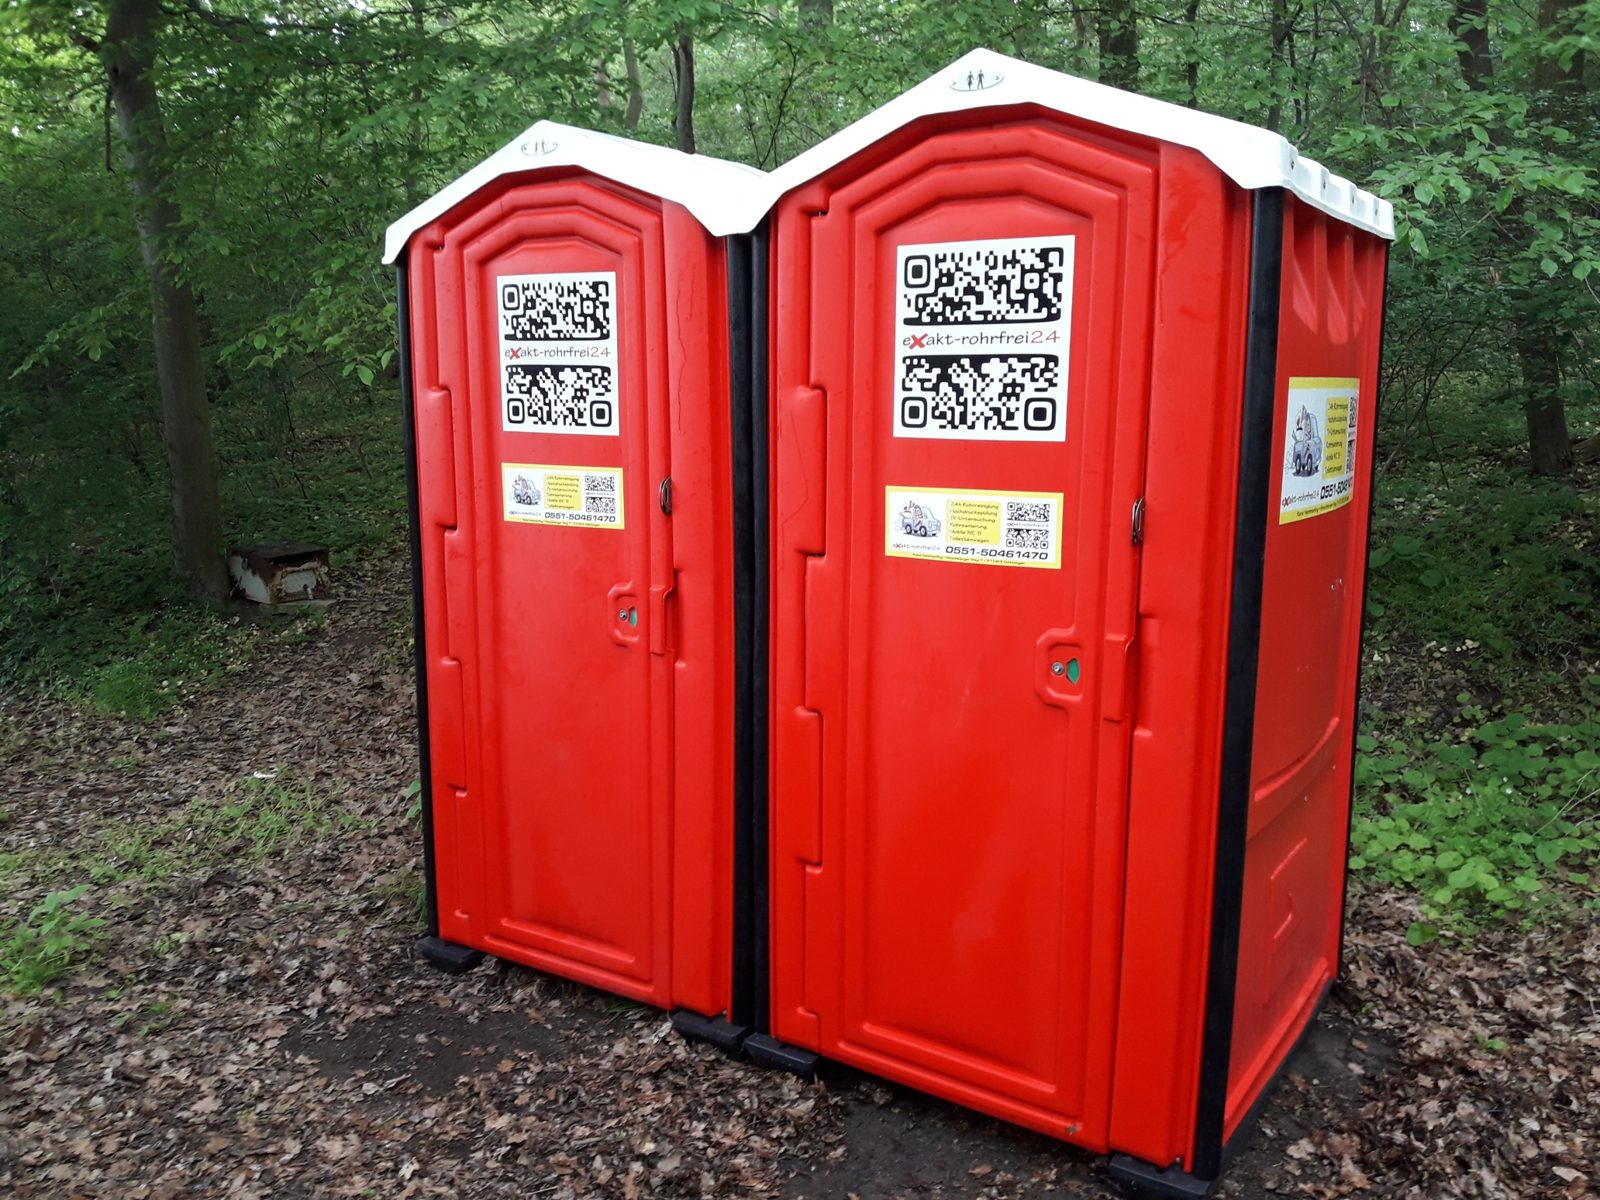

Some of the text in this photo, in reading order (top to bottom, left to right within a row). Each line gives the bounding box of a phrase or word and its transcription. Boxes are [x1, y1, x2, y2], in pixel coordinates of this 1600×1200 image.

[902, 330, 1061, 350] eXakt-rohrfrei24
[504, 346, 611, 360] eXakt-rohrfrei24
[544, 511, 616, 523] 0551-50461470
[945, 546, 1049, 560] 0551-50461470
